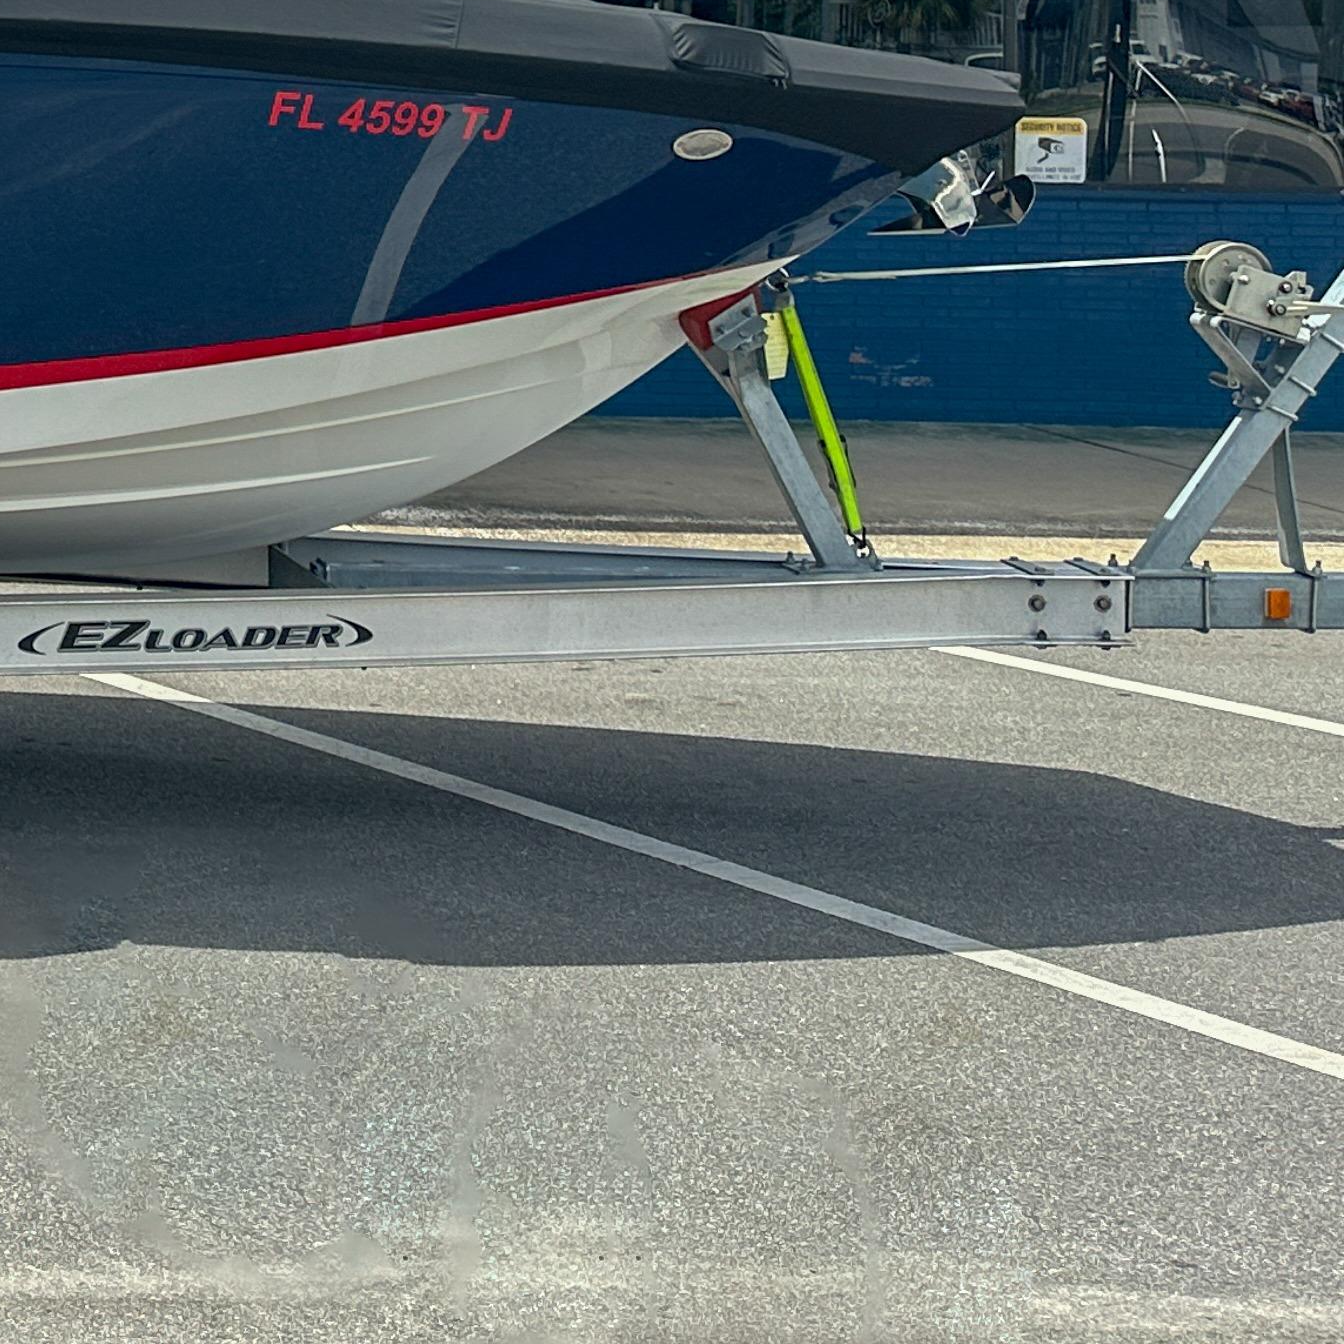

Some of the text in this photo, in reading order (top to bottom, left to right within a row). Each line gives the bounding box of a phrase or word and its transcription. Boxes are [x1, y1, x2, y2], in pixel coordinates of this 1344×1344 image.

[267, 91, 514, 142] FL 4599 TJ
